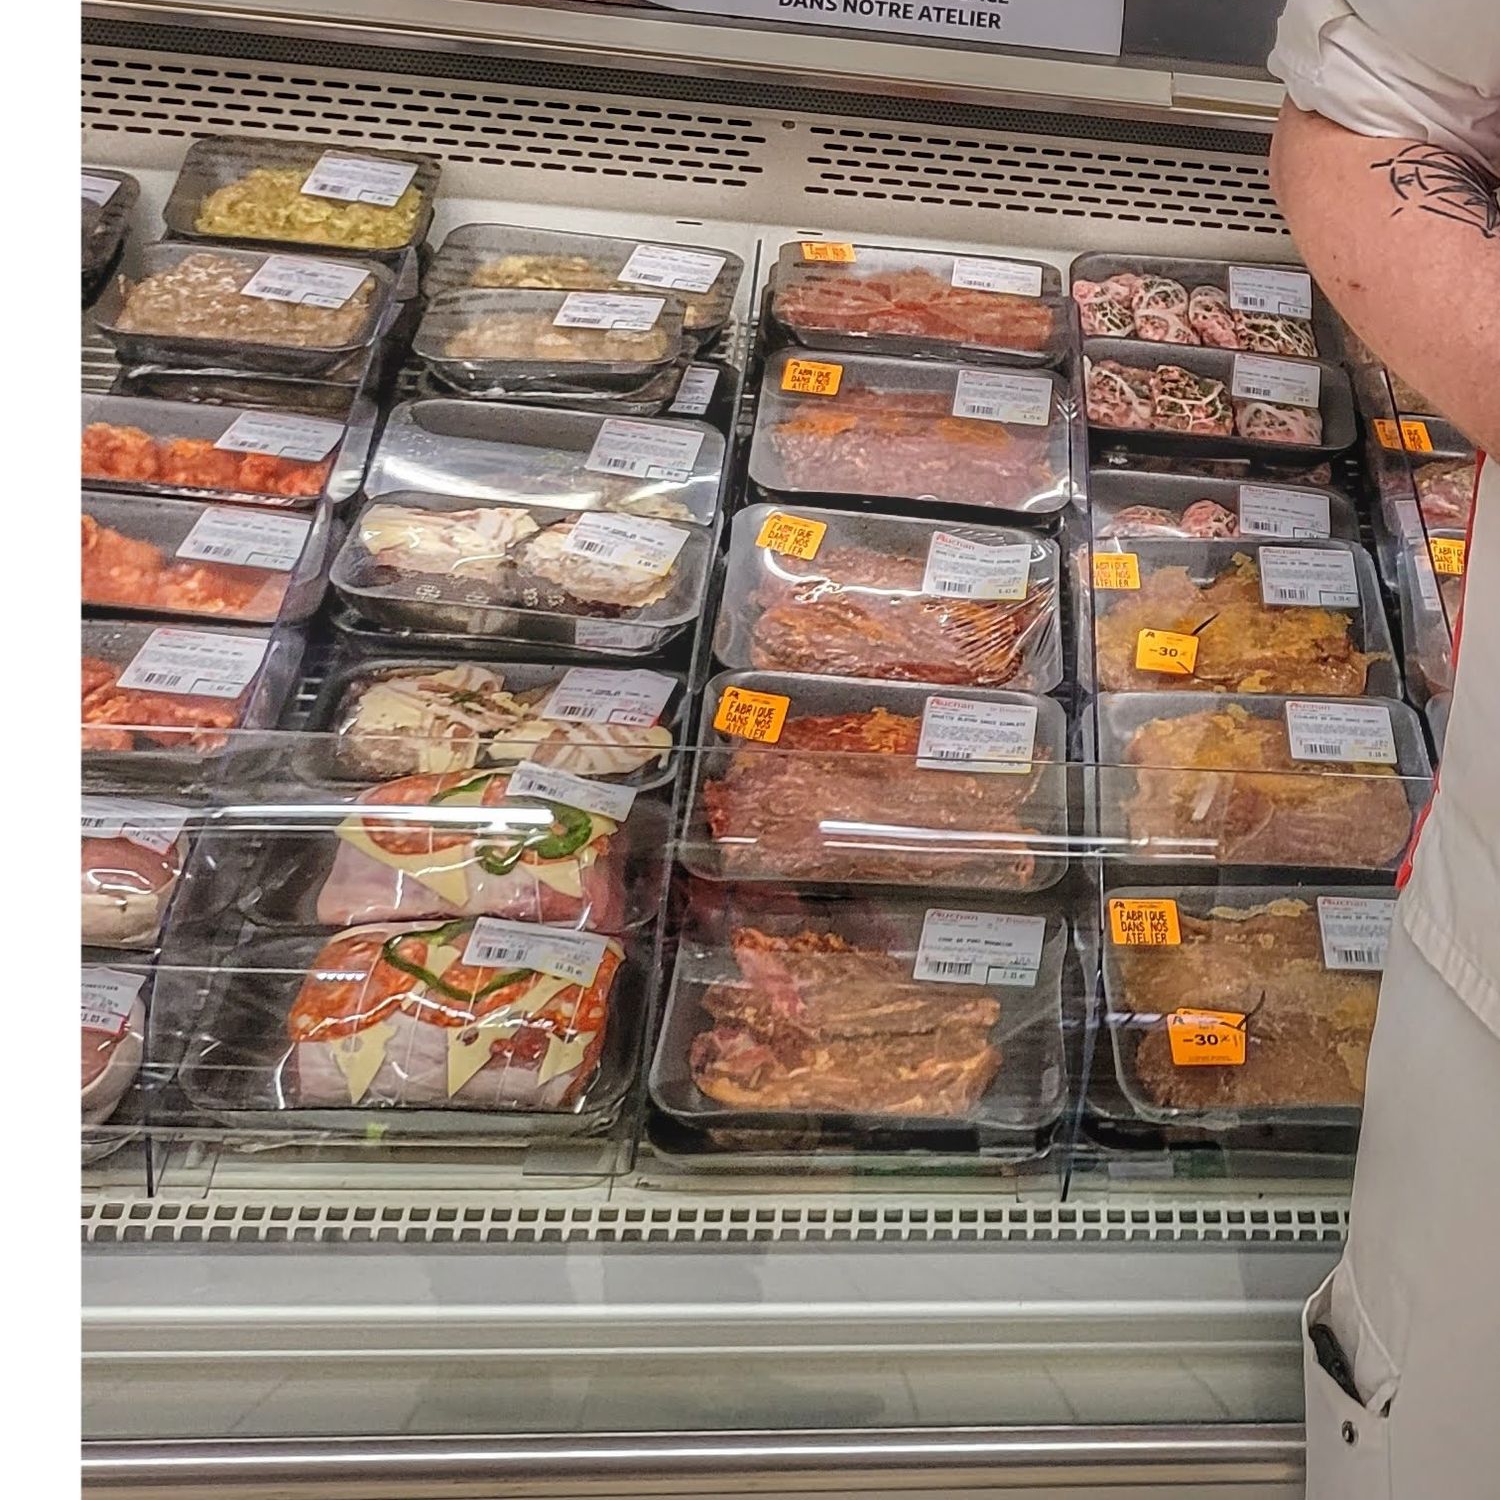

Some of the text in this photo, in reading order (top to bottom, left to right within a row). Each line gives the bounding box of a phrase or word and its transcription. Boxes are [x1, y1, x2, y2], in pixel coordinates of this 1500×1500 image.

[918, 4, 1002, 30] ATELIER
[1120, 910, 1167, 921] FABRIQUE
[1120, 919, 1169, 933] DANS NOS
[1126, 932, 1167, 945] ATELIER
